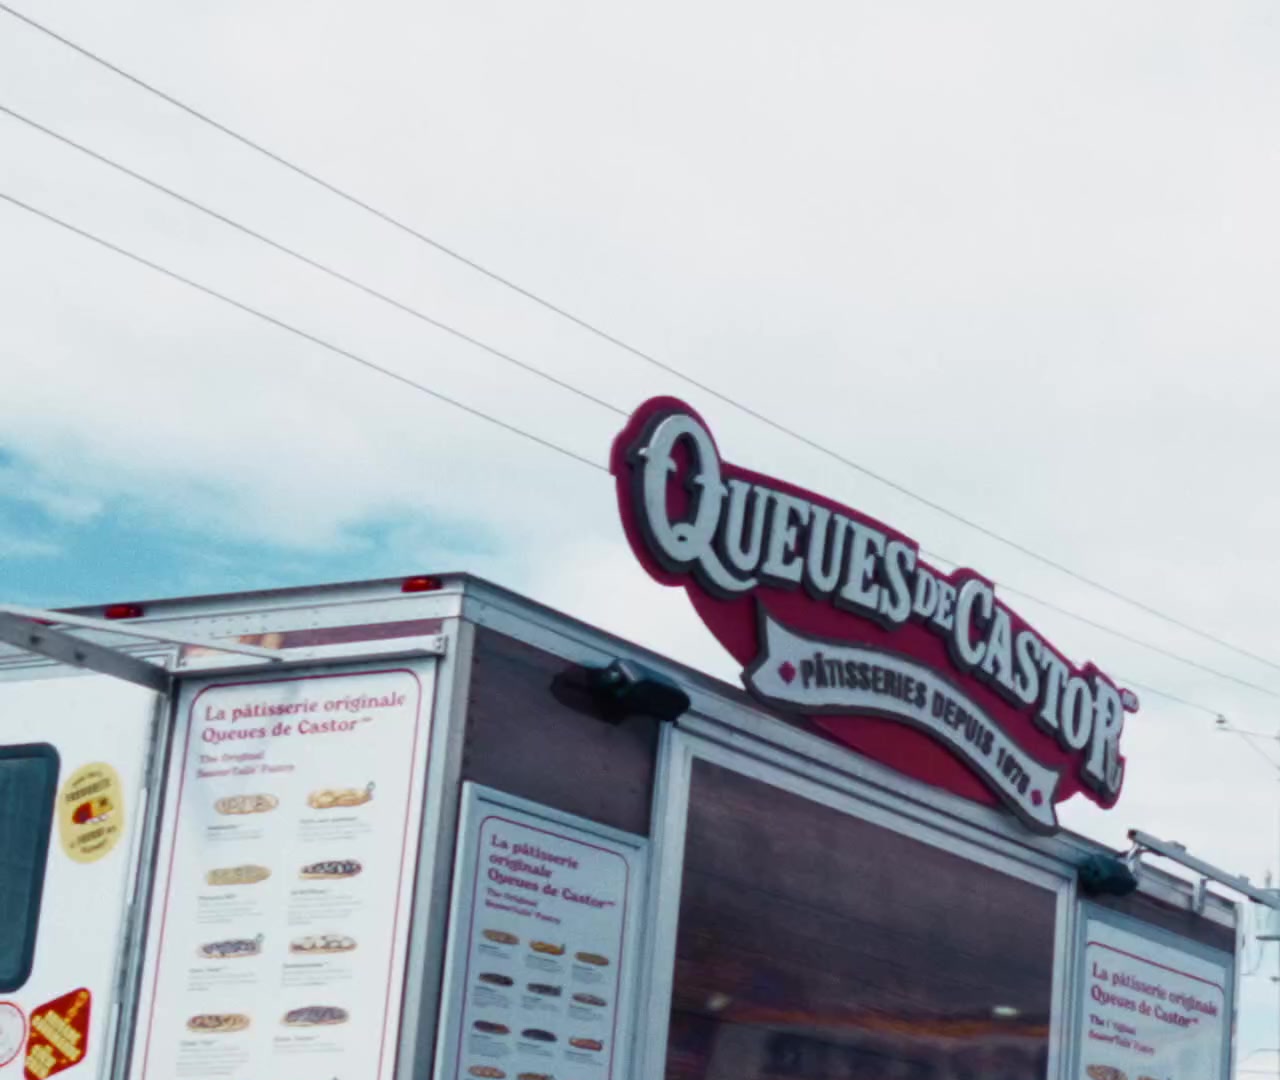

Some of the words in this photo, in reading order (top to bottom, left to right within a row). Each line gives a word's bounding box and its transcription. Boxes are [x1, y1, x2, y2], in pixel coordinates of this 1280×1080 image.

[632, 410, 918, 627] QUEUES
[914, 567, 957, 632] DE
[954, 578, 1124, 795] CASTOR
[204, 705, 226, 722] La
[231, 699, 317, 723] pâtisserie
[323, 691, 406, 713] originale
[800, 651, 927, 709] PÂTISSERIES
[931, 689, 995, 757] DEPUIS
[201, 725, 267, 744] Queues
[271, 722, 292, 737] de
[489, 853, 553, 878] originale
[490, 834, 508, 848] La
[512, 842, 579, 870] pâtisserie
[487, 867, 539, 892] Queues
[542, 883, 559, 896] de
[1092, 960, 1108, 981] La
[1112, 972, 1168, 1000] pâtisserie
[1091, 984, 1137, 1012] Queues
[1138, 999, 1152, 1017] de
